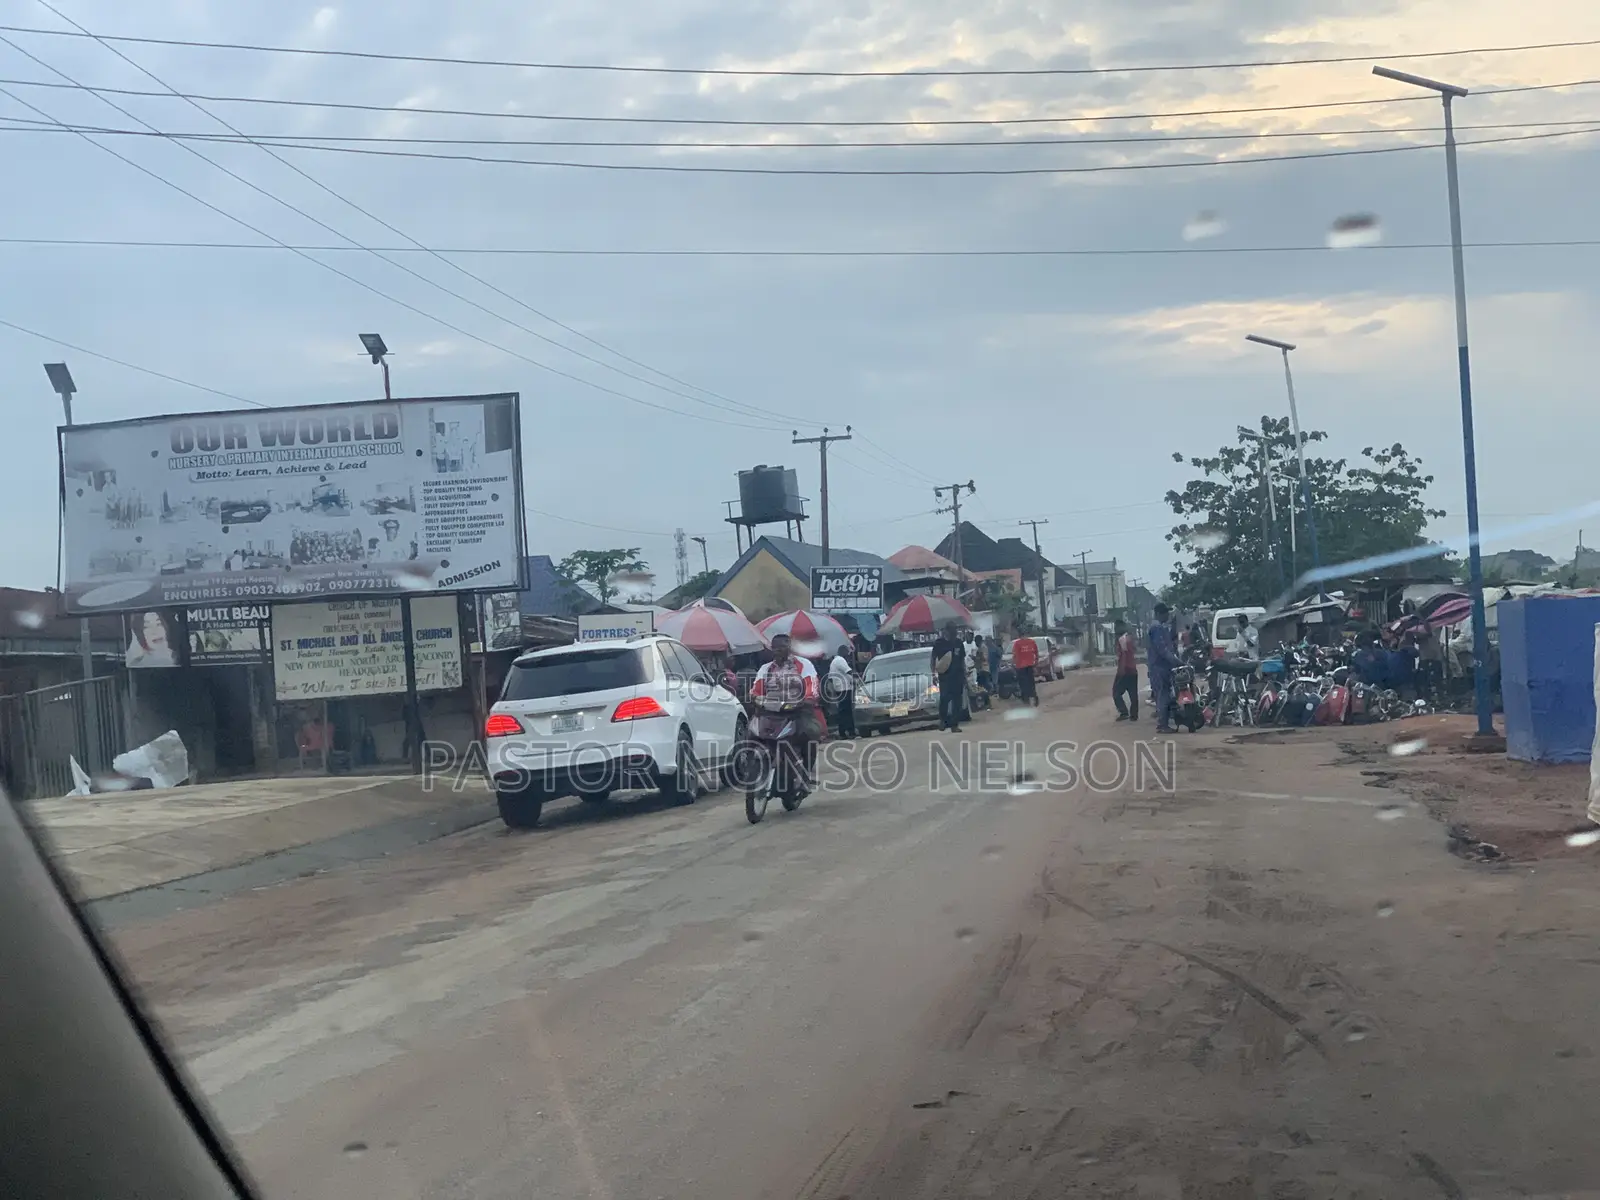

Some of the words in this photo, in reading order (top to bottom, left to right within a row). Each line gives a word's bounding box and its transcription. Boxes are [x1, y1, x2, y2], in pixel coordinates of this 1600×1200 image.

[170, 421, 248, 454] OUR
[258, 412, 399, 448] WORLD
[168, 453, 217, 470] NURSERY
[218, 455, 226, 466] &
[227, 449, 275, 465] PRIMARY
[276, 445, 357, 463] INTERNATIONAL
[356, 442, 404, 457] SCHOOL
[196, 471, 232, 481] Motto:
[235, 467, 272, 478] Learn,
[276, 464, 321, 475] Achieve
[324, 462, 335, 472] &
[338, 460, 367, 471] Lead
[443, 478, 469, 486] LEARNING
[470, 476, 508, 484] ENVIRONMENT
[438, 493, 471, 501] ACQUISITION
[440, 501, 465, 509] EQUIPPED
[466, 513, 504, 522] LABORATORIES
[441, 523, 466, 531] EQUIPPED
[467, 521, 495, 529] COMPUTER
[459, 529, 486, 537] CHILDCARE
[437, 559, 501, 588] ADMISSION
[820, 573, 879, 595] bet9ja
[164, 587, 232, 601] ENQUIRIES:
[187, 607, 229, 623] MULTI
[232, 605, 270, 620] BEAU
[280, 639, 294, 651] ST.
[297, 636, 336, 650] MICHAEL
[340, 634, 358, 647] AND
[362, 633, 377, 645] ALL
[381, 630, 404, 643] ANGE
[415, 627, 452, 640] CHURCH
[582, 627, 637, 639] FORTRESS
[297, 649, 323, 658] Federal
[284, 662, 304, 671] NEW
[307, 658, 344, 669] OWERRI
